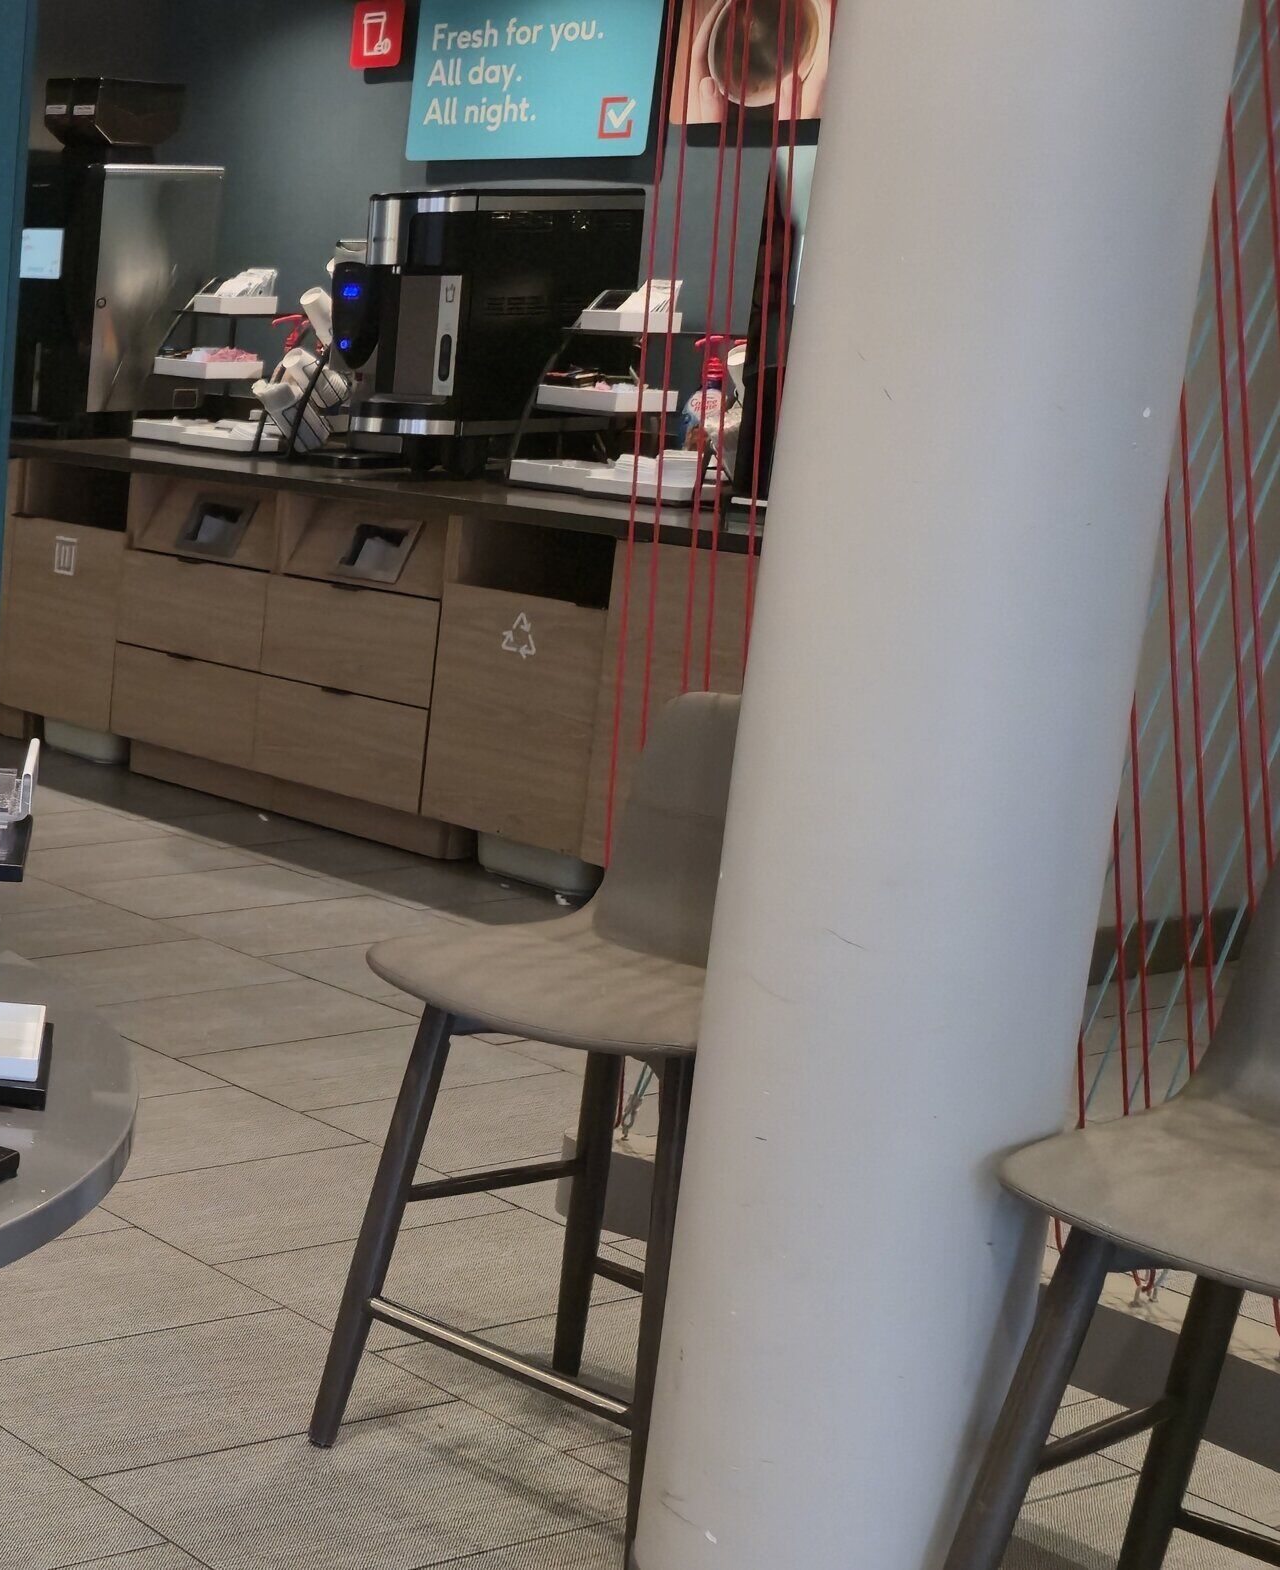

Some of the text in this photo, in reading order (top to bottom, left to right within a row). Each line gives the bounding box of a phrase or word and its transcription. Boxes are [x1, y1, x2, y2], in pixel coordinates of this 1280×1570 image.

[432, 17, 604, 52] Fresh for you.
[427, 56, 523, 92] All day.
[423, 95, 536, 132] All night.
